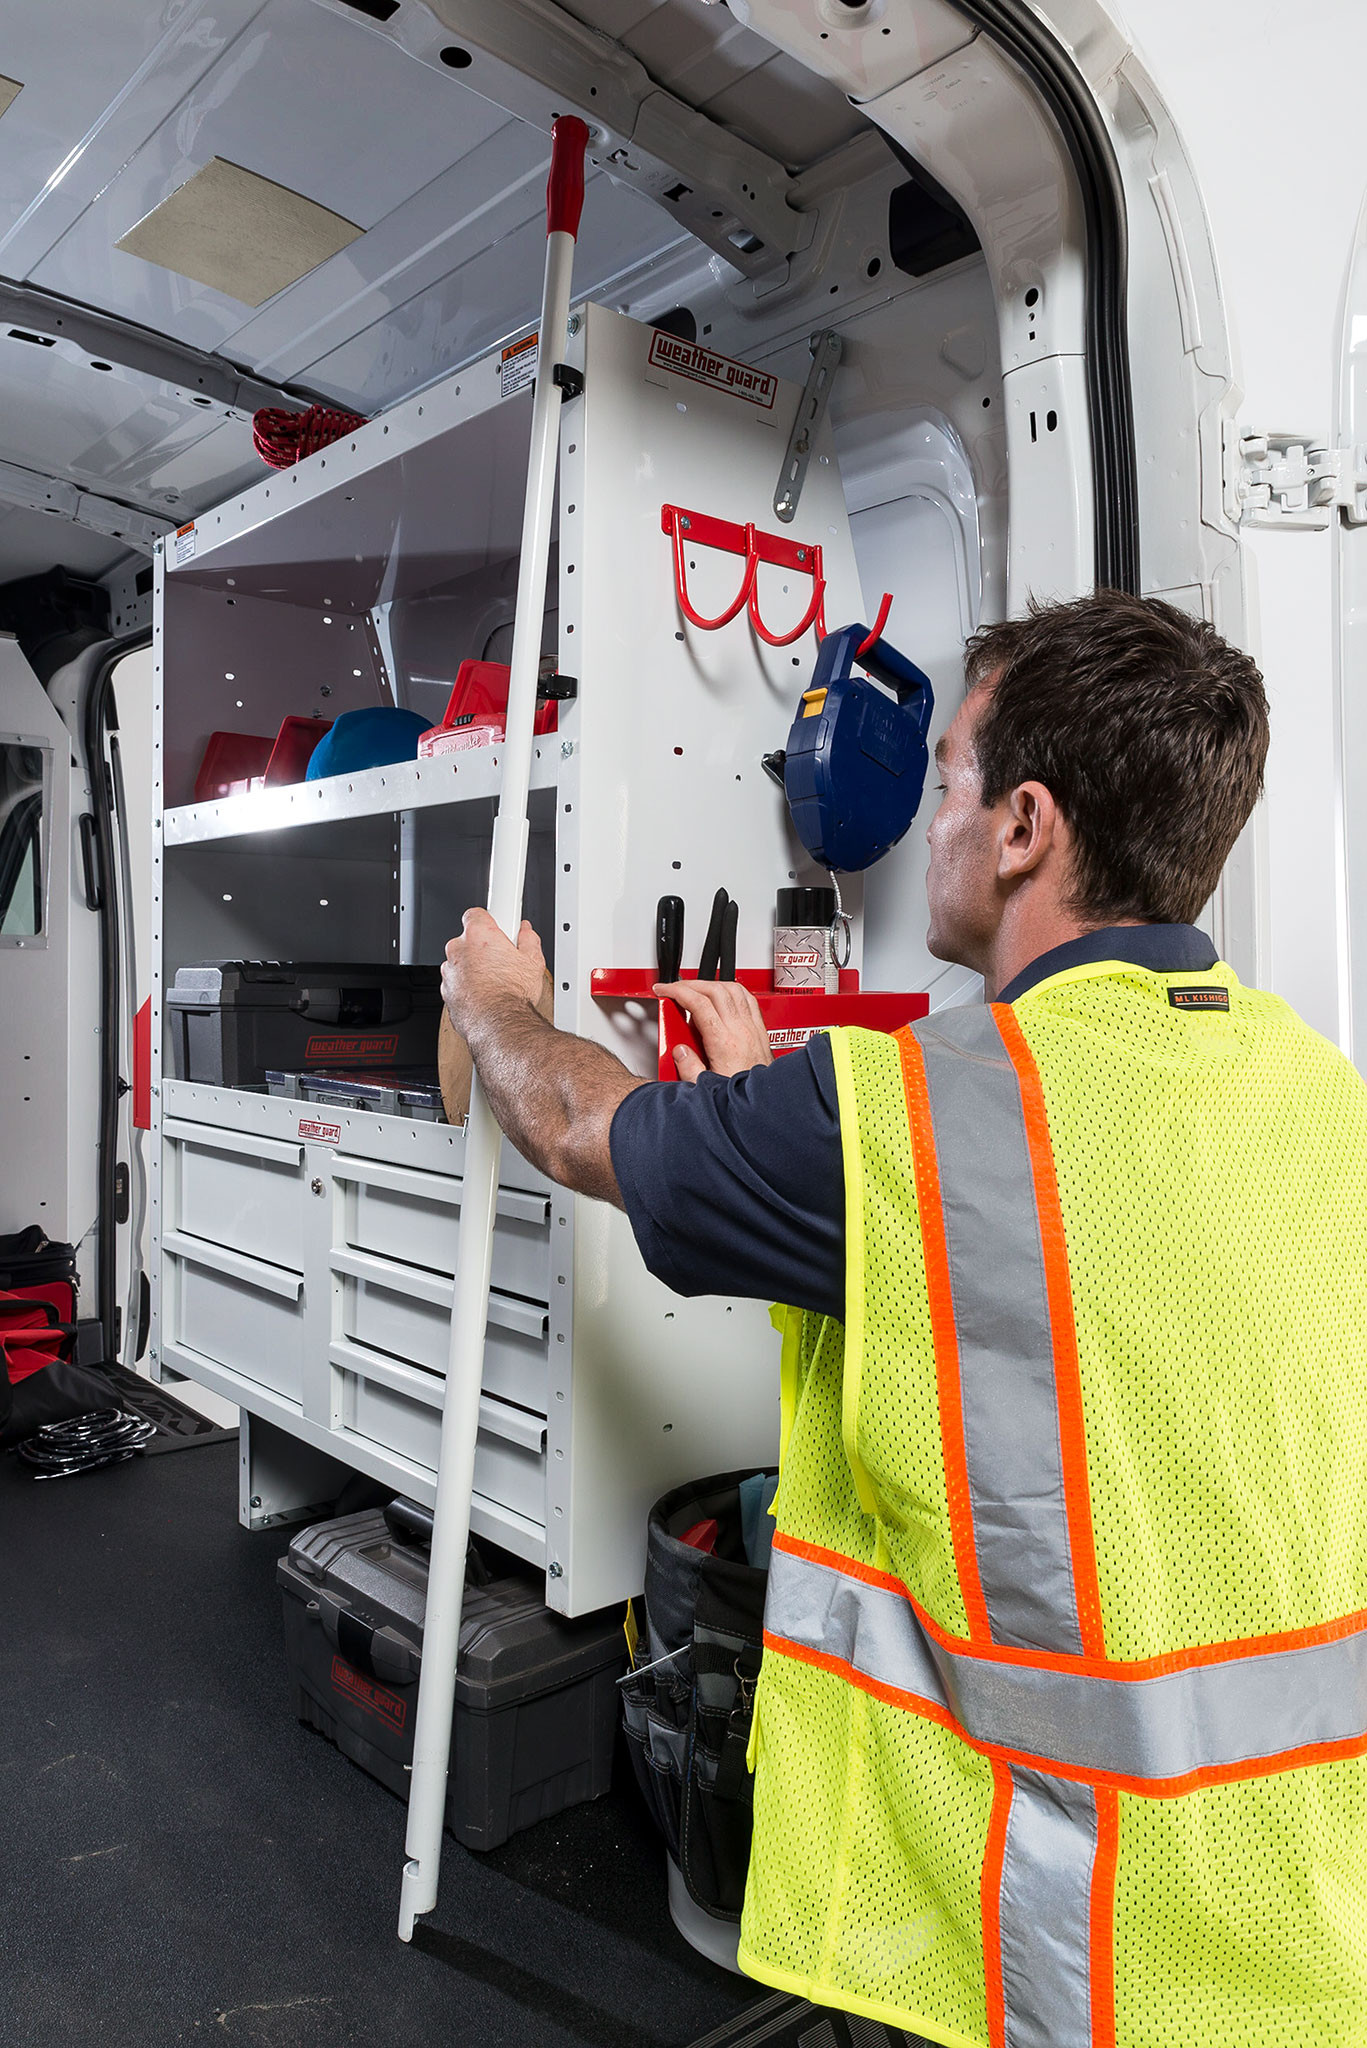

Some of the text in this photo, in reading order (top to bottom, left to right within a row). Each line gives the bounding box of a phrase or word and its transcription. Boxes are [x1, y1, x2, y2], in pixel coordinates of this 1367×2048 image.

[656, 338, 772, 396] weather guard
[787, 953, 816, 965] guard
[1174, 994, 1228, 1003] ML KISHIGO
[311, 1038, 393, 1053] weather guard
[335, 1661, 373, 1696] weather
[374, 1688, 402, 1718] guard
